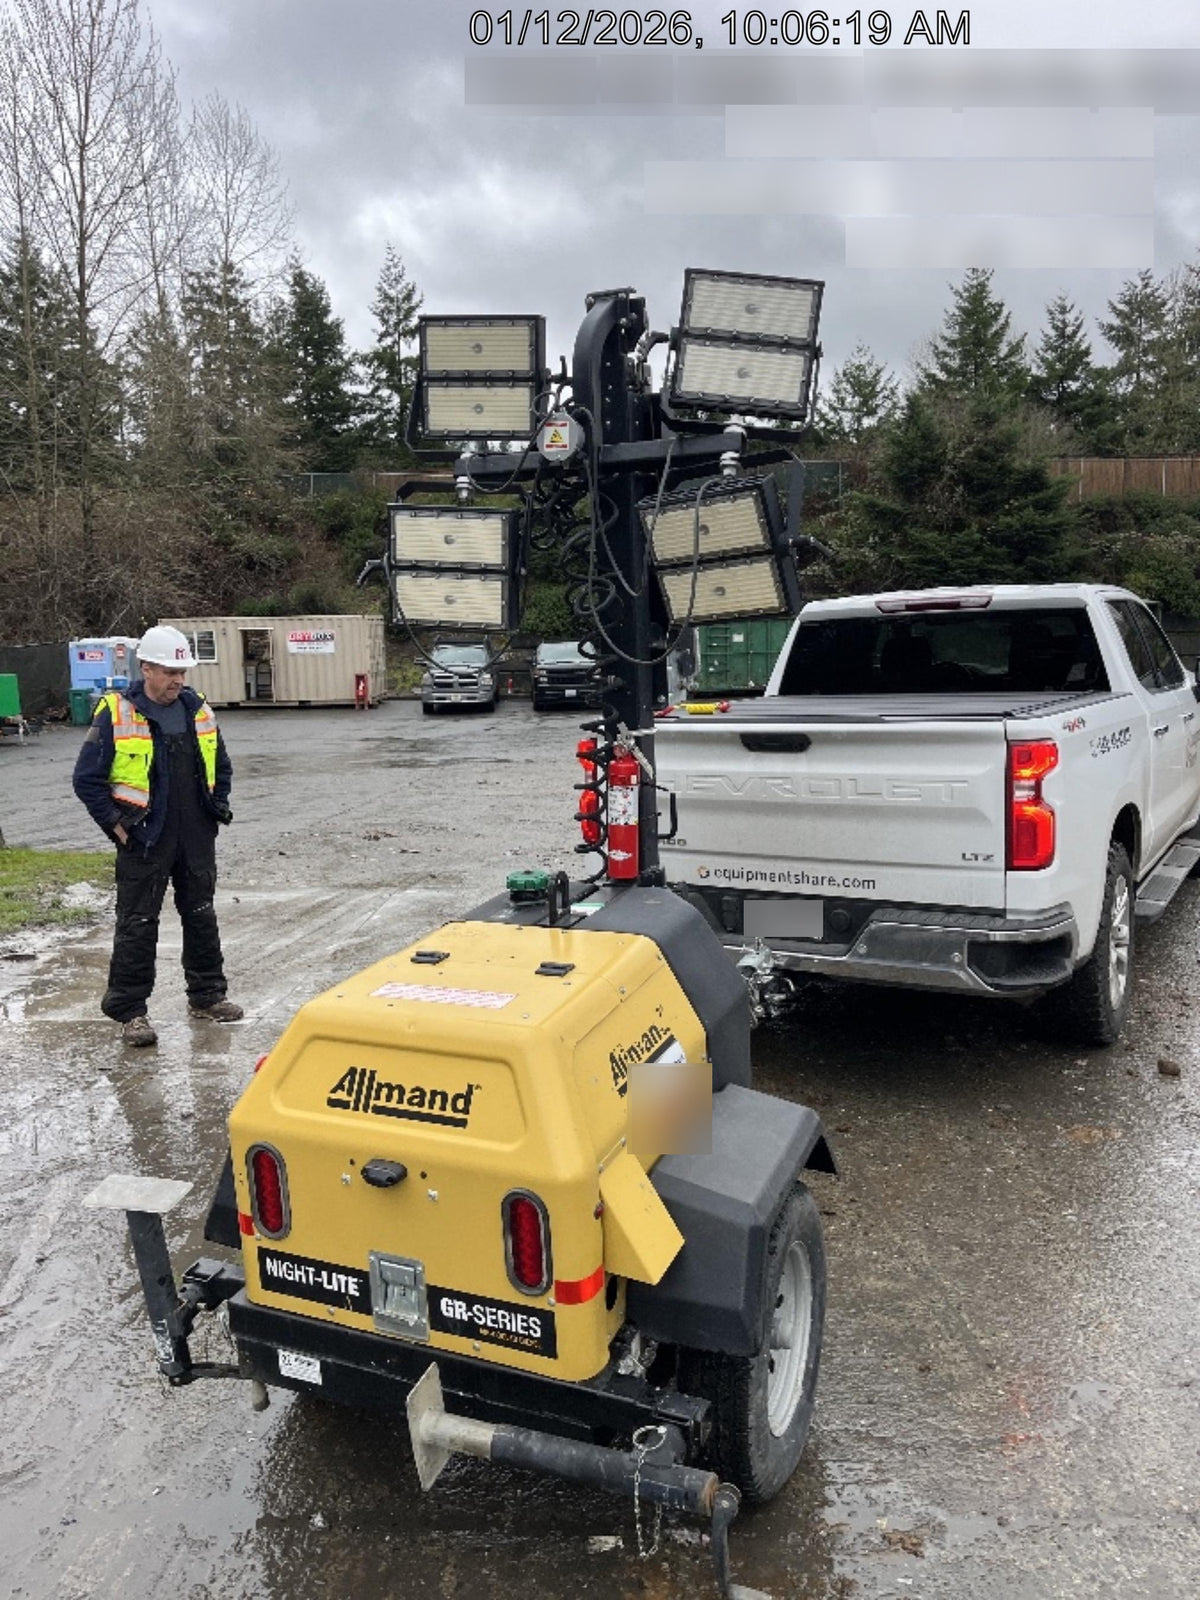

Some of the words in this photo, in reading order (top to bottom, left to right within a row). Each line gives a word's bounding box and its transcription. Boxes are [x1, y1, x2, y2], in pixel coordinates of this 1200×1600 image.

[961, 852, 994, 862] LTZ
[714, 867, 876, 890] equipmentshare.com
[327, 1066, 475, 1115] Allmand
[265, 1256, 360, 1297] NIGHT-LITE
[440, 1297, 541, 1338] GR-SERIES
